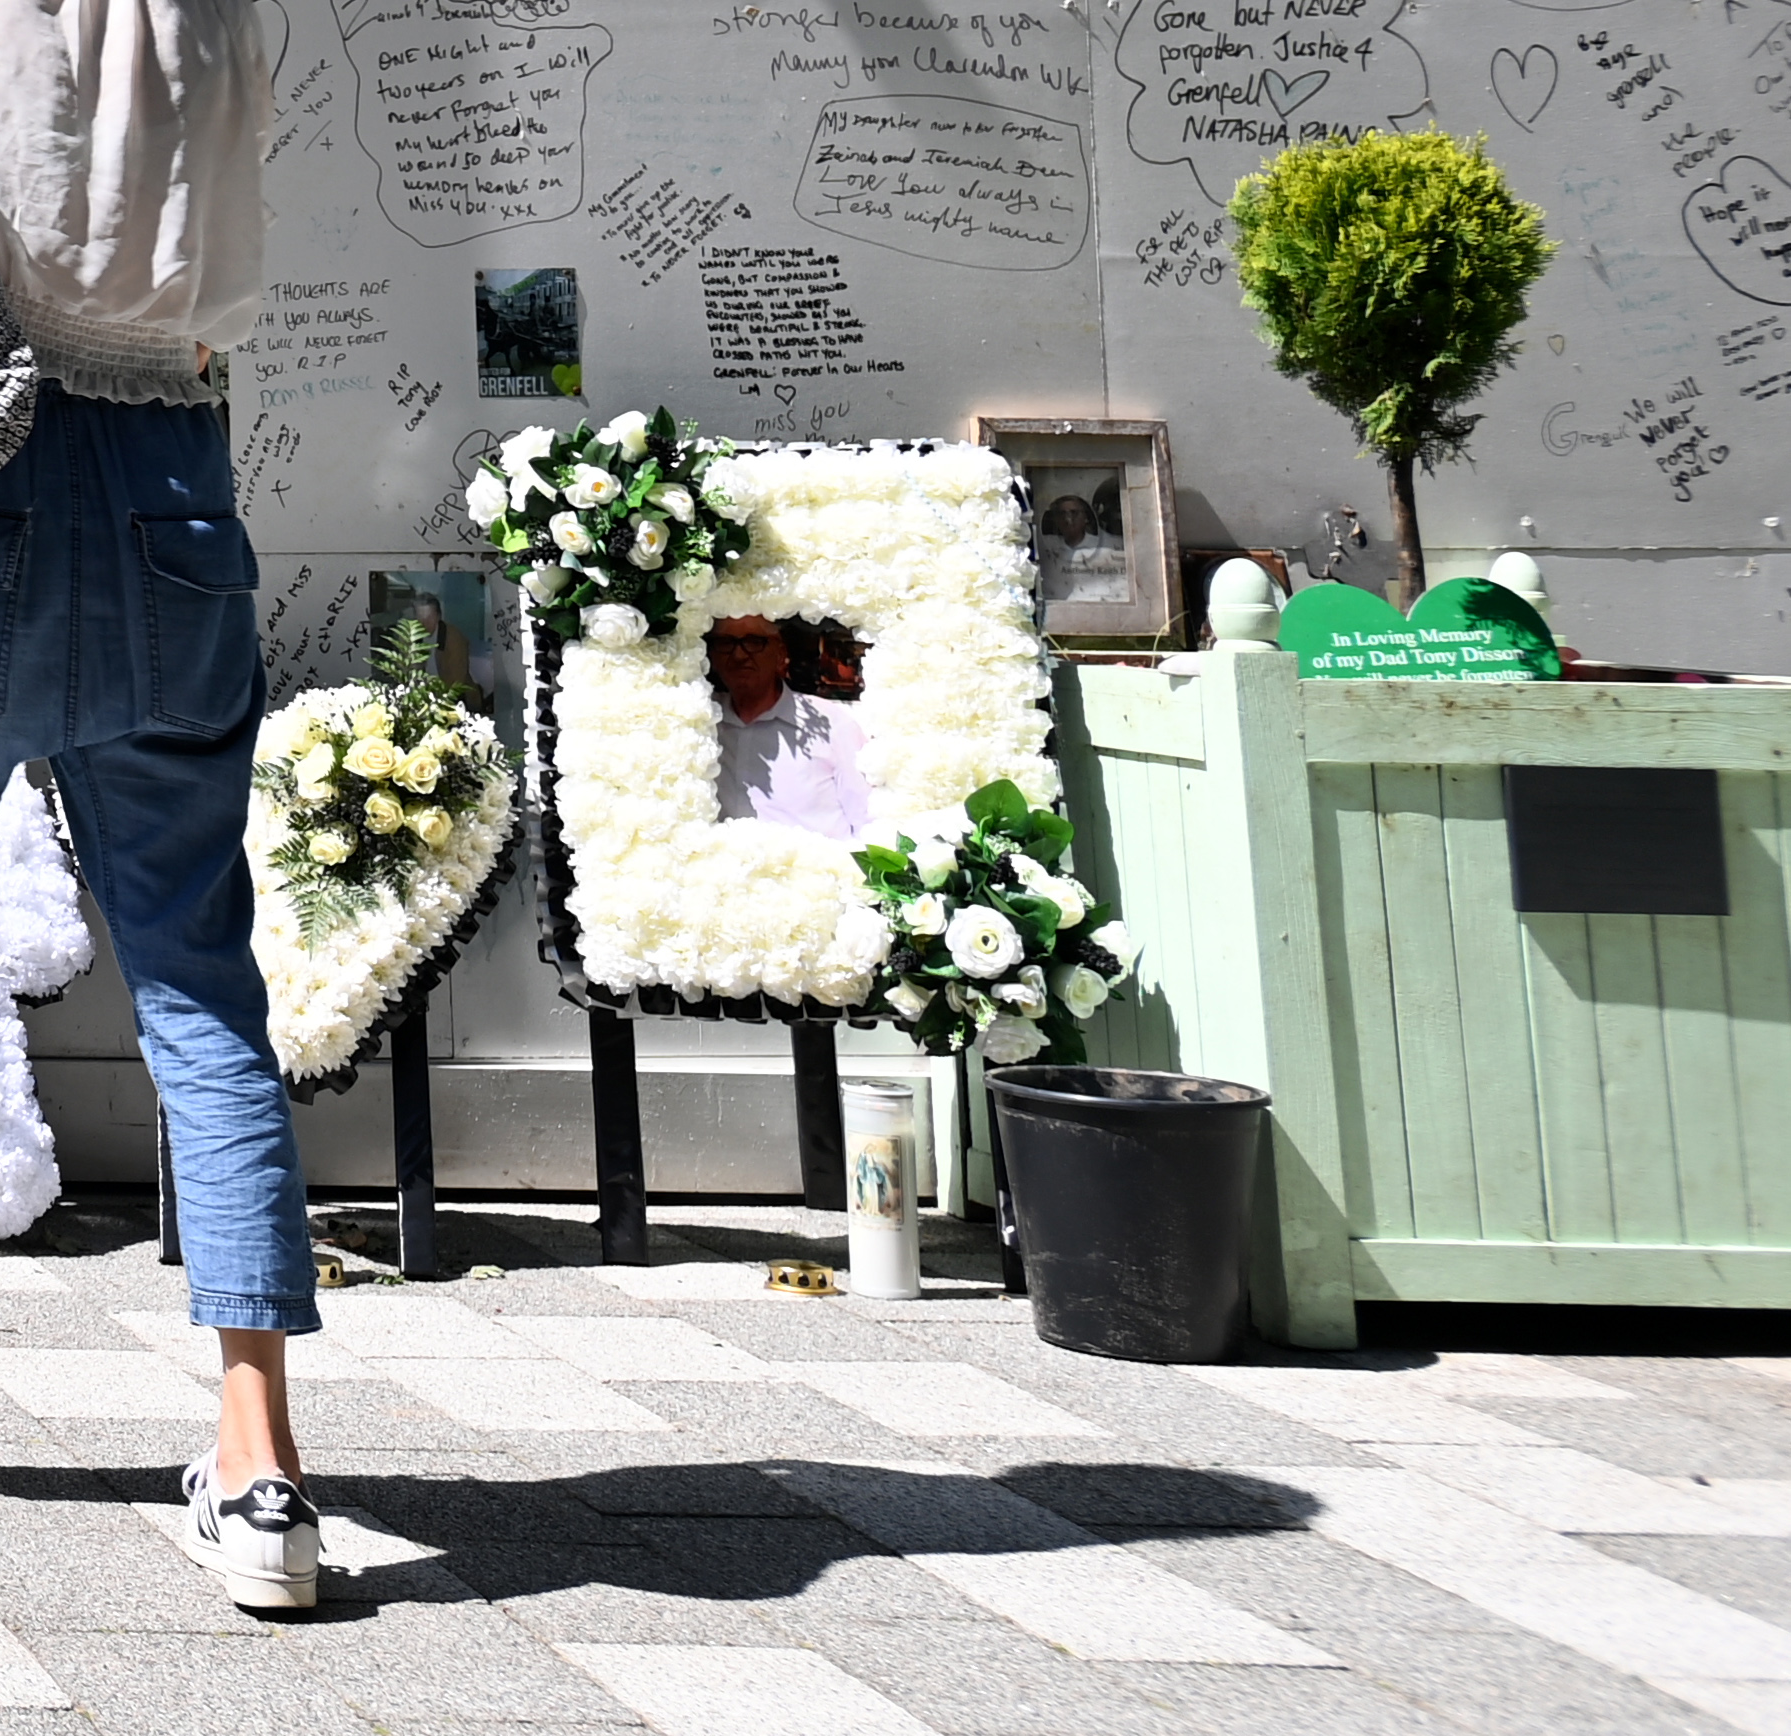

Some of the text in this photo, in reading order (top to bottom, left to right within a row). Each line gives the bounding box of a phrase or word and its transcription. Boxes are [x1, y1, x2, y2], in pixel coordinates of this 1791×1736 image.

[1153, 0, 1214, 33] Gone
[1272, 30, 1349, 63] Justice
[1354, 37, 1373, 72] 4
[1167, 73, 1261, 115] Grenfell
[1182, 115, 1290, 146] NATASHA
[480, 376, 548, 396] GRENFELL
[1331, 629, 1493, 647] In Loving Memory
[1313, 647, 1525, 670] of my Dad Tony Disson
